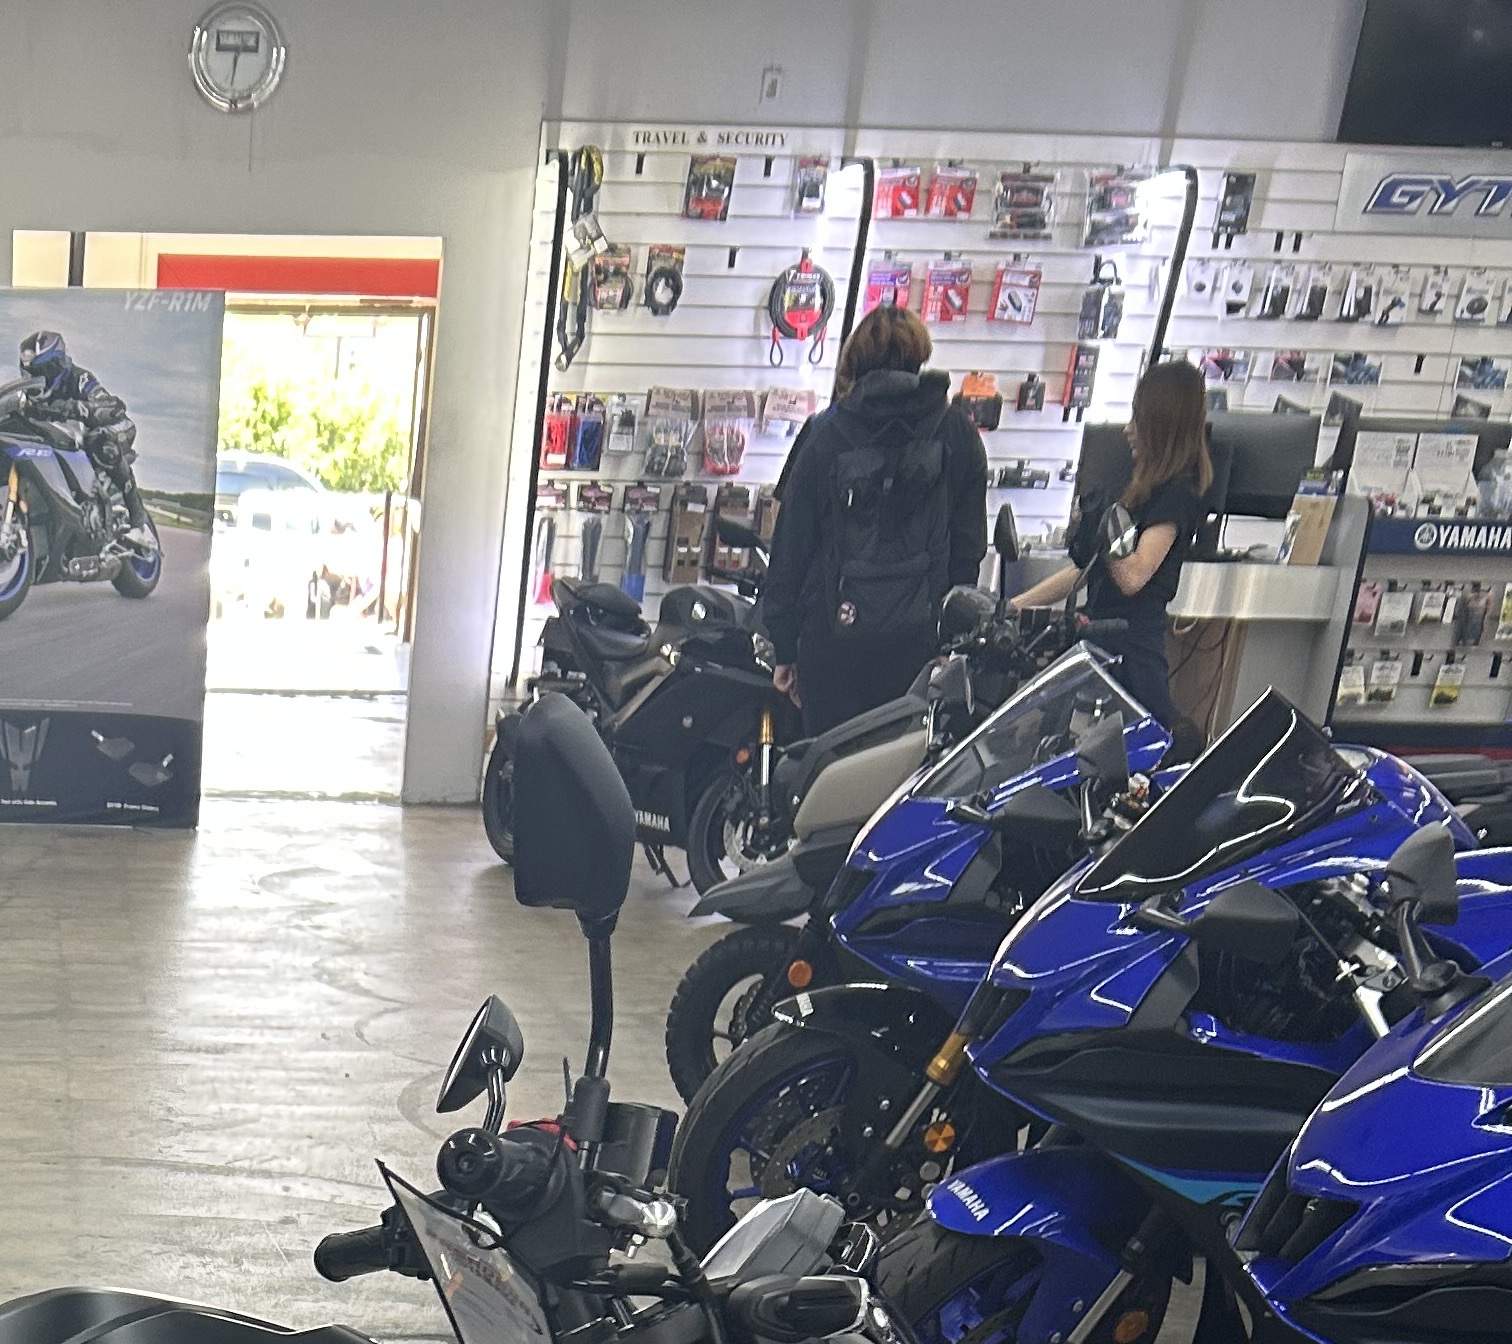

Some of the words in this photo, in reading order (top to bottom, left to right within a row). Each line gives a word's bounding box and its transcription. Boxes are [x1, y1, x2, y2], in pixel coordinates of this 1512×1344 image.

[632, 130, 689, 145] TRAVEL
[697, 130, 708, 144] &
[717, 131, 788, 146] SECURITY
[1361, 172, 1512, 217] GYT
[124, 291, 213, 312] YZF-R1M
[1439, 524, 1512, 549] YAMAHA
[634, 810, 671, 832] YAMAHA
[947, 1179, 990, 1222] YAMAHA
